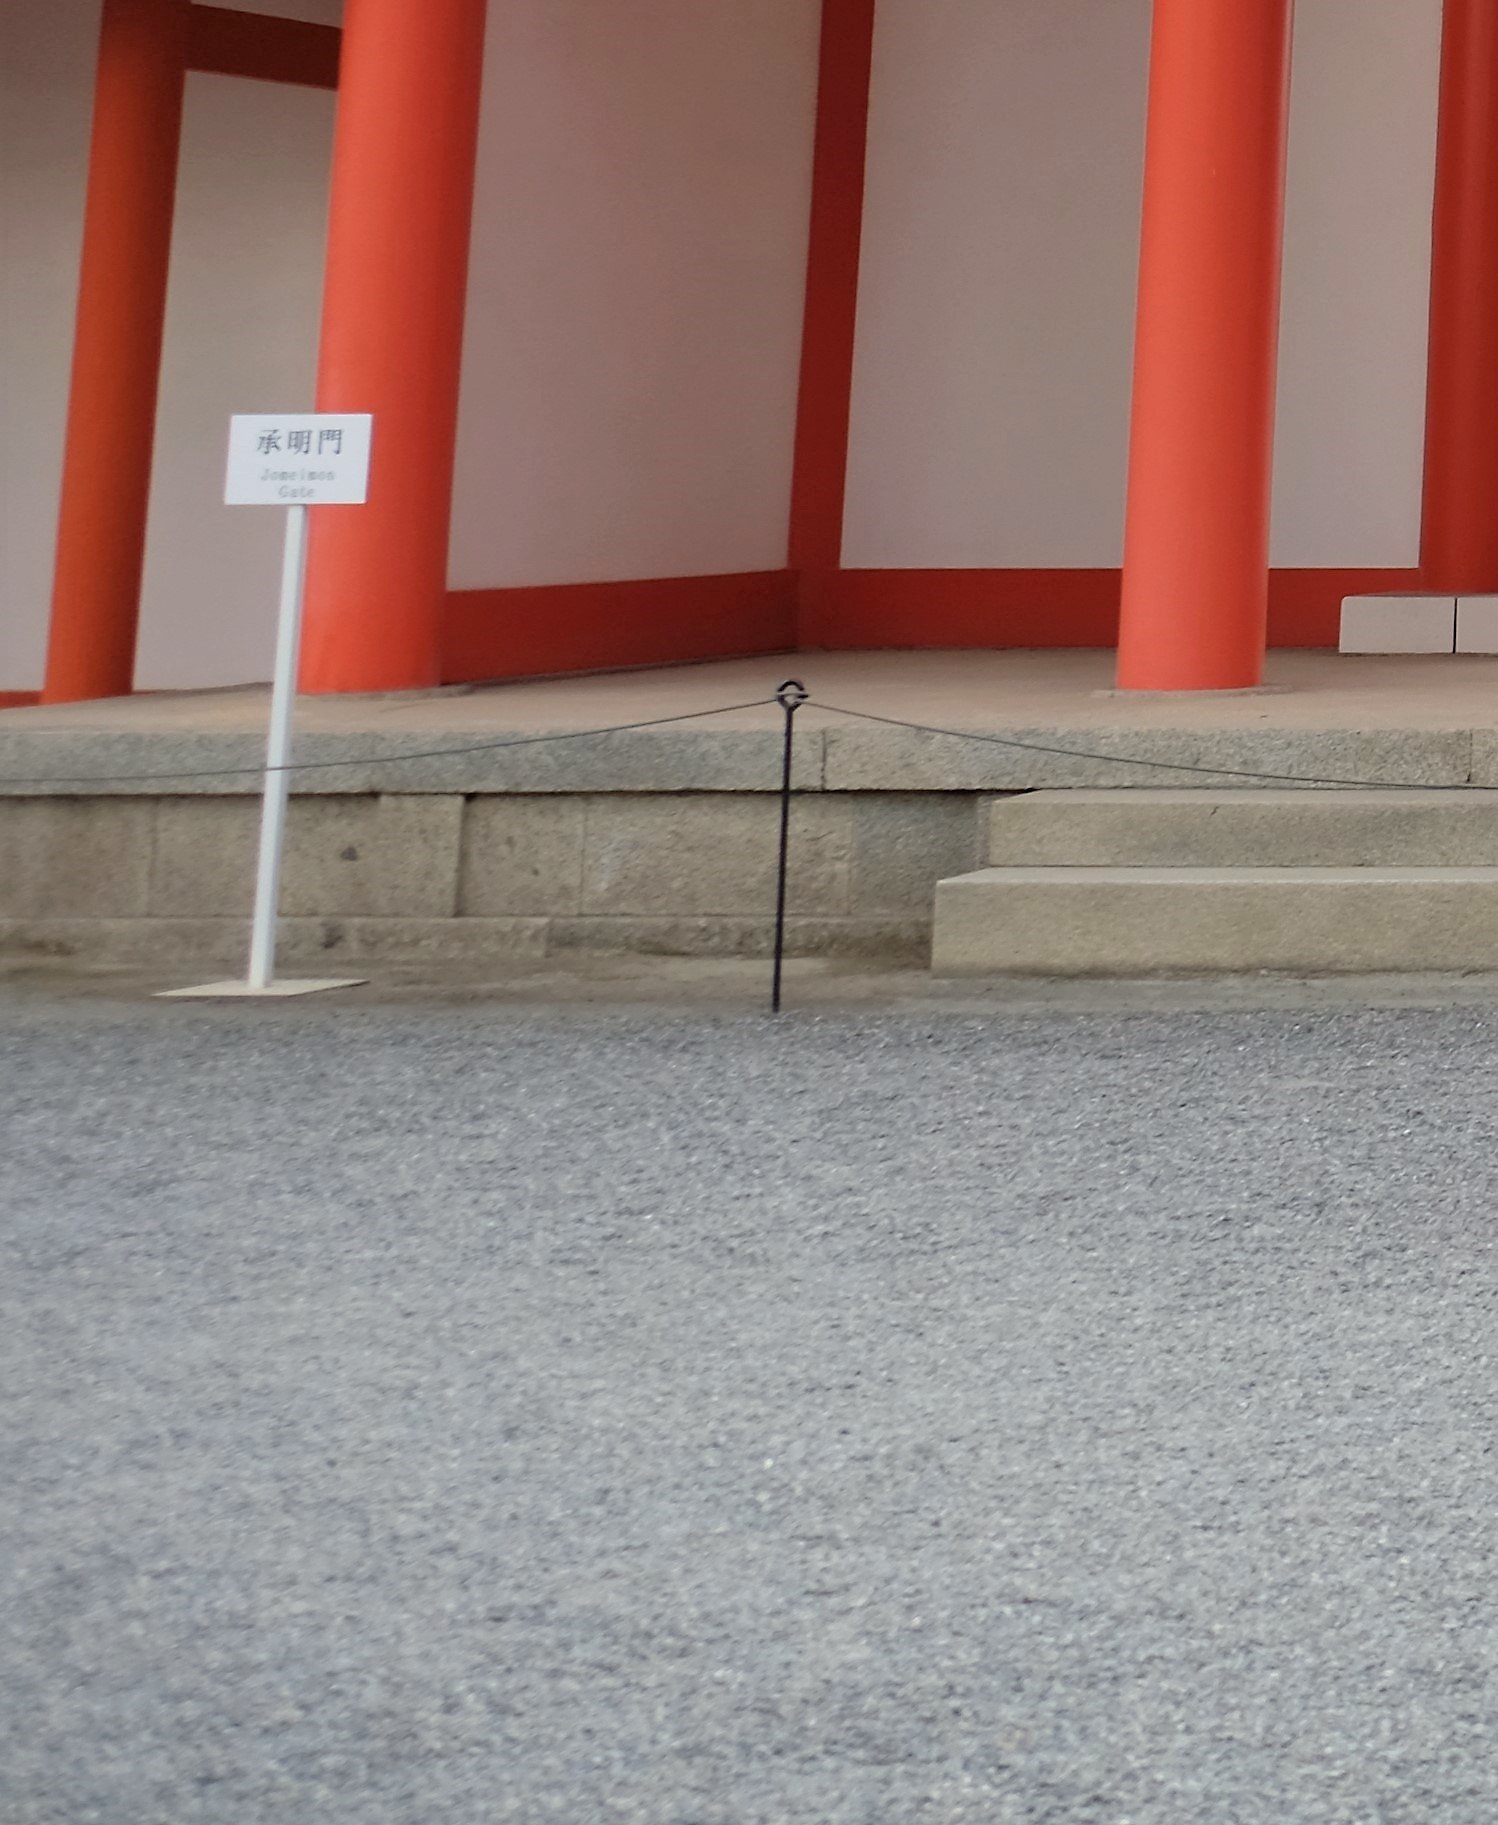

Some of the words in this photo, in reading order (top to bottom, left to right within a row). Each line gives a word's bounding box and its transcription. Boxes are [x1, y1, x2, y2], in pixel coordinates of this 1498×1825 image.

[256, 428, 344, 455] 承明門
[278, 485, 315, 499] Gate
